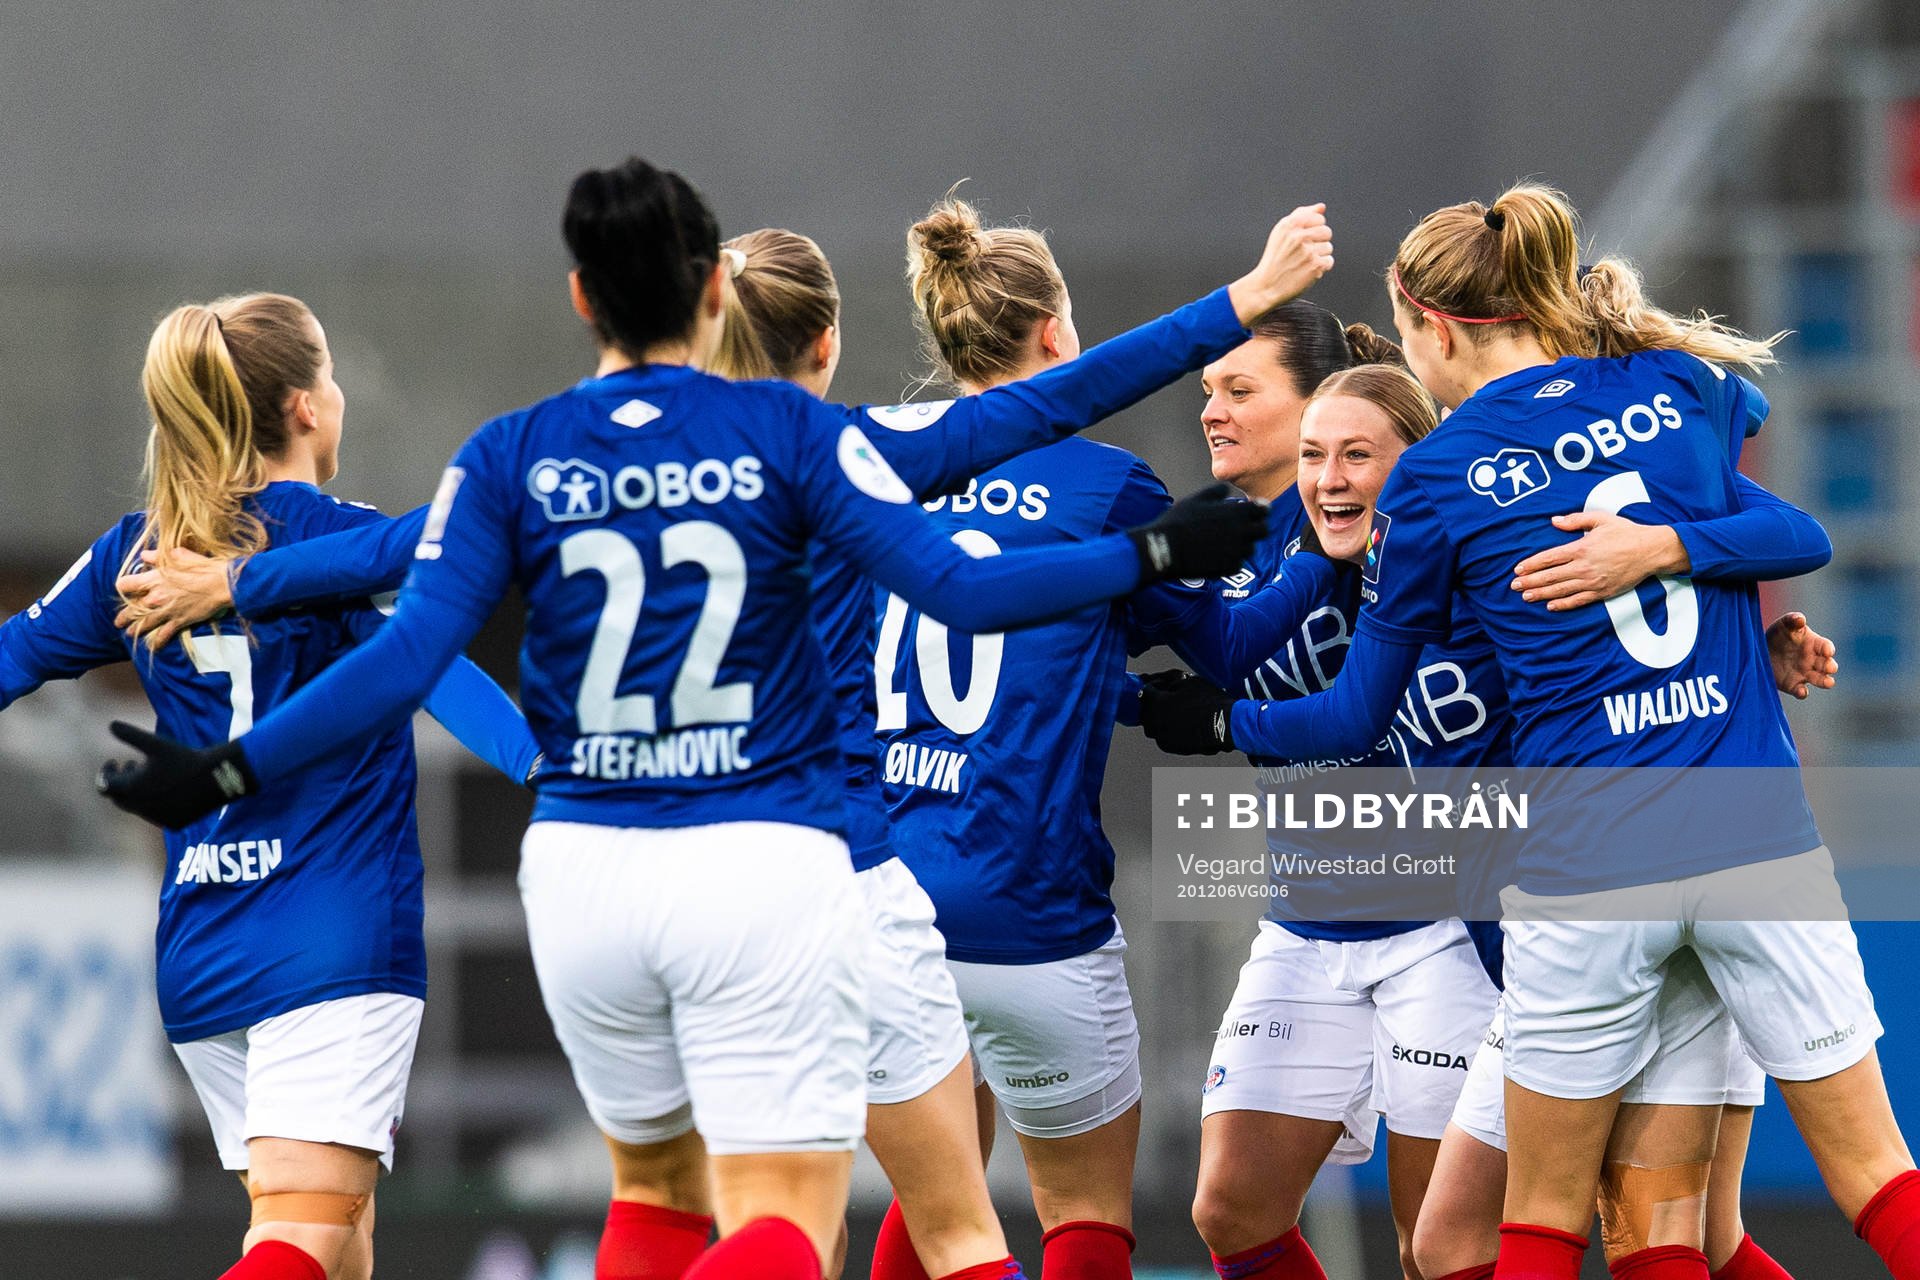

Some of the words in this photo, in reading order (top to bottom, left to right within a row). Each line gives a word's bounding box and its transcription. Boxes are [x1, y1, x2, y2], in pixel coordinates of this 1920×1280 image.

[1554, 393, 1683, 471] OBOS
[613, 455, 765, 509] OBOS
[1583, 471, 1698, 669] 6
[559, 520, 754, 735] 22
[190, 635, 254, 821] 7
[1603, 675, 1729, 736] WALDUS
[571, 726, 752, 780] STEFANOVIC
[882, 742, 968, 793] ØLVIK
[1268, 1021, 1292, 1040] Bil
[1803, 1023, 1857, 1052] umbro
[1006, 1071, 1070, 1088] umbro
